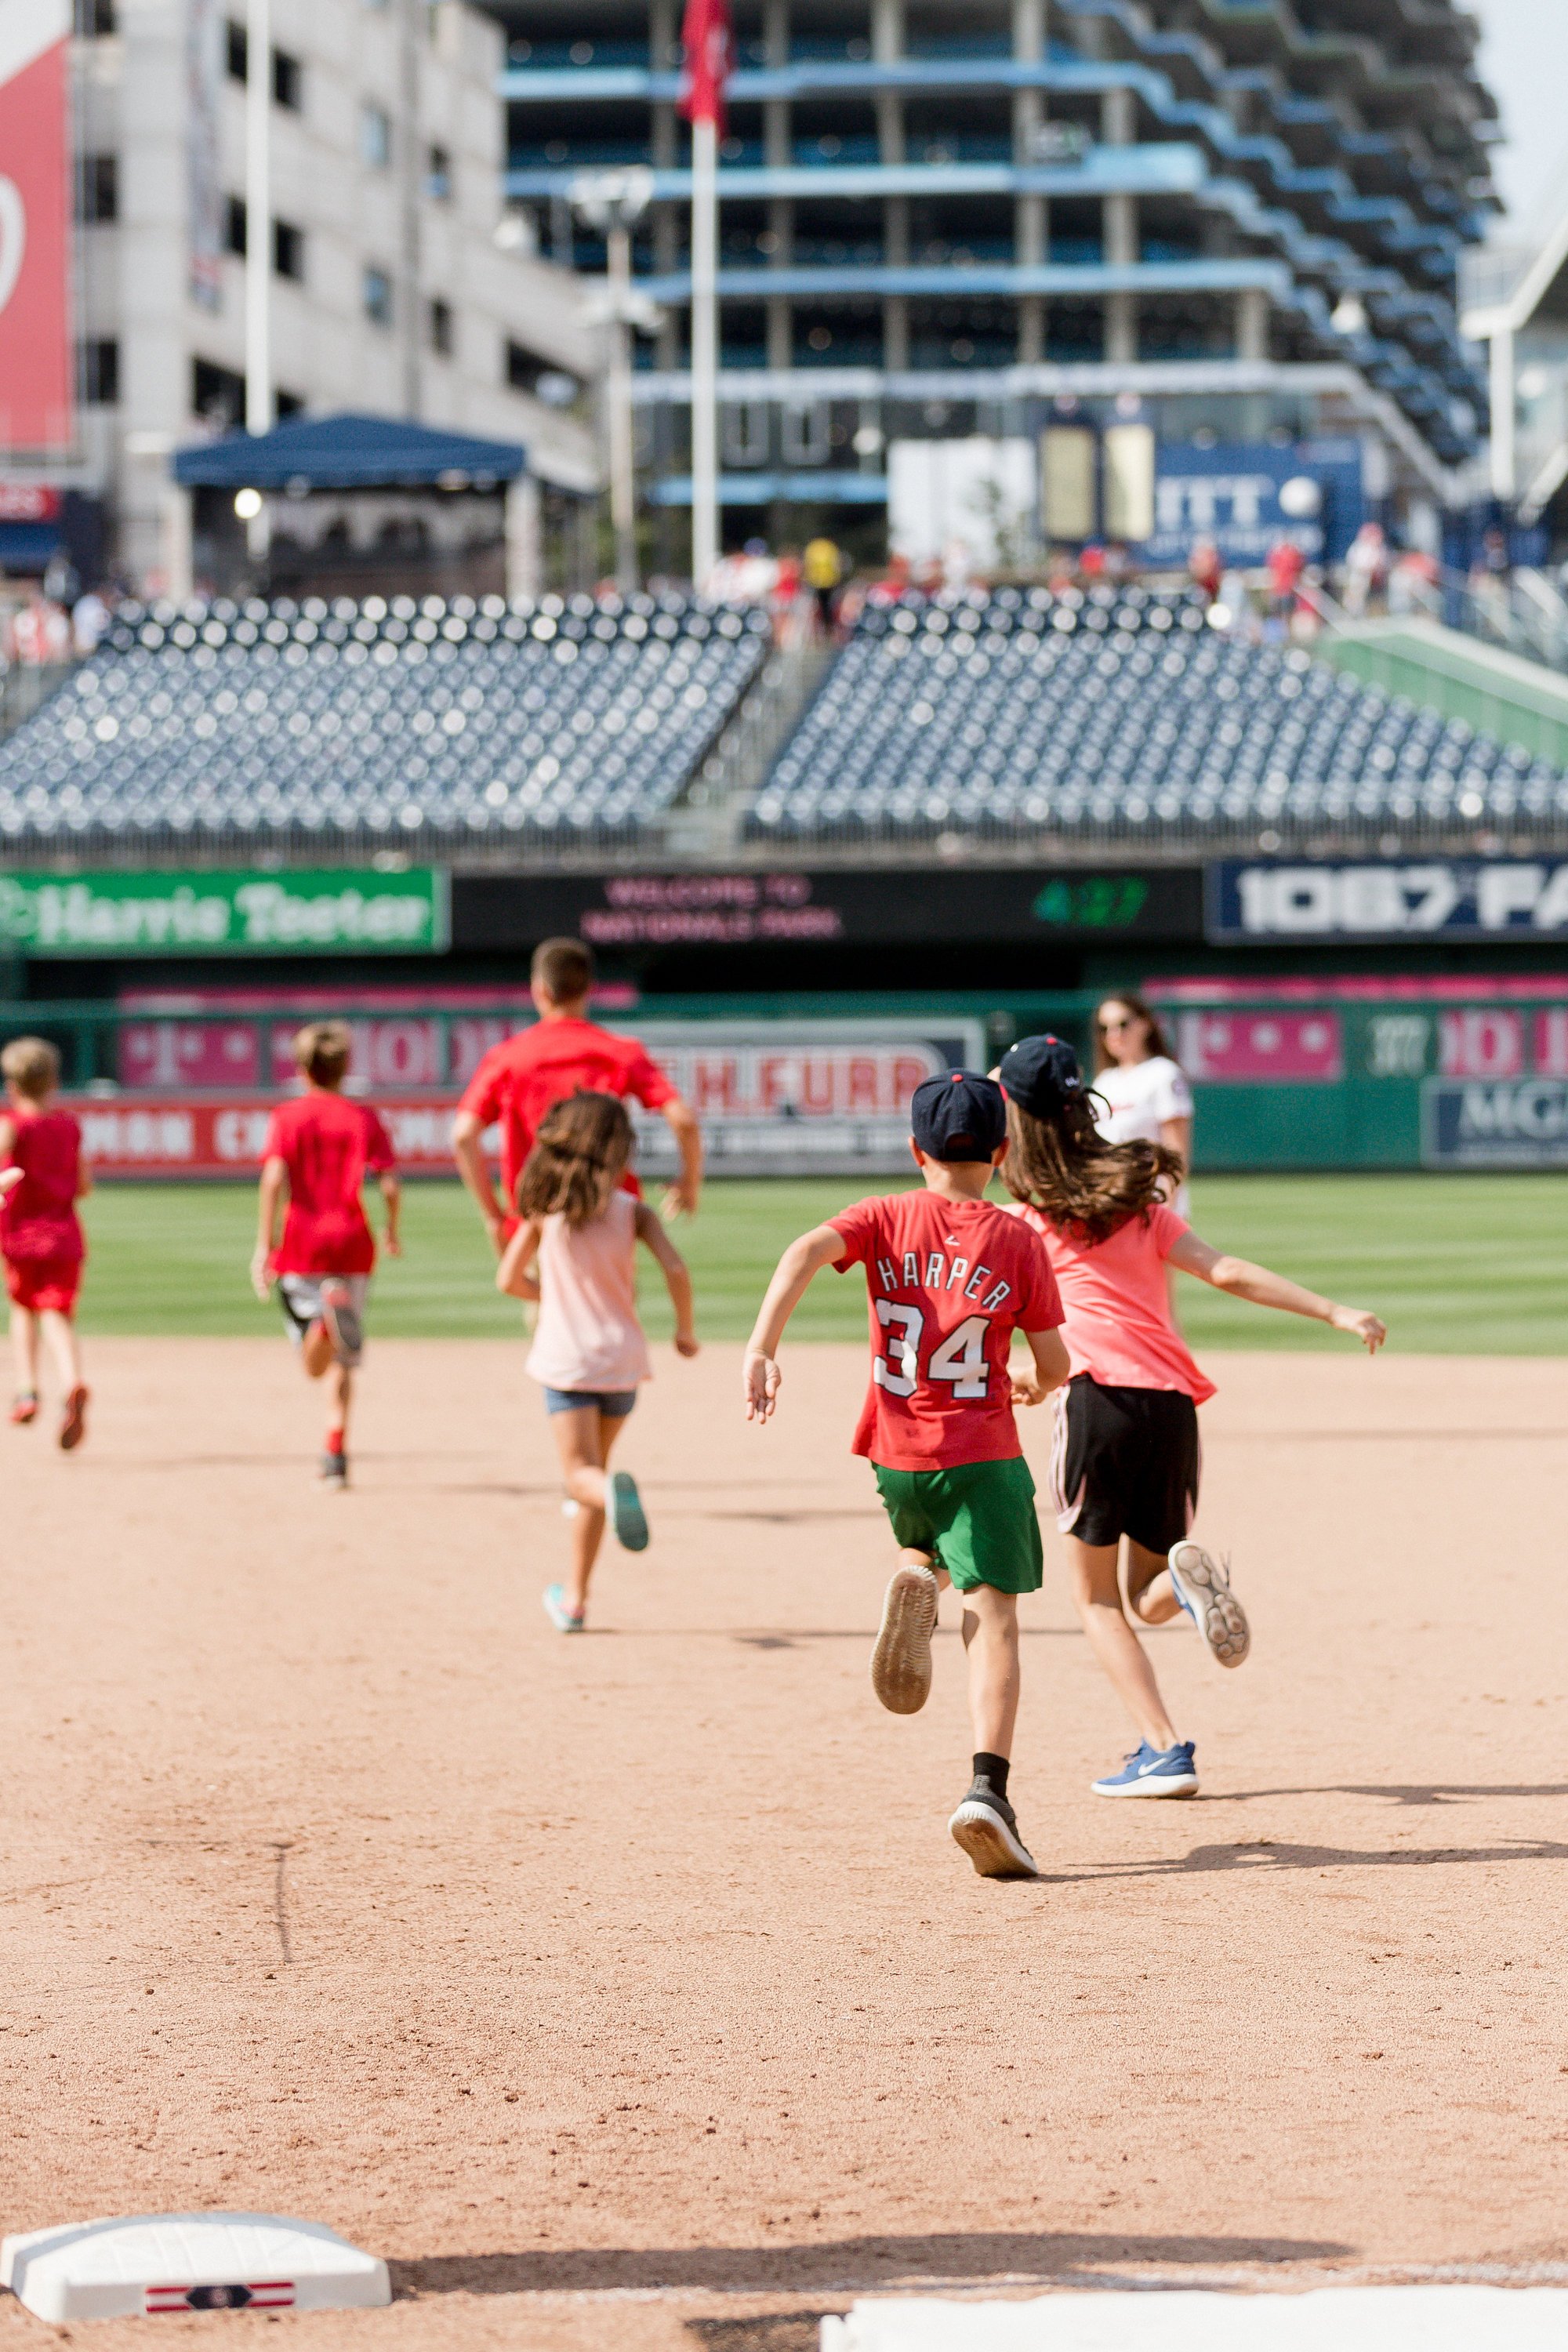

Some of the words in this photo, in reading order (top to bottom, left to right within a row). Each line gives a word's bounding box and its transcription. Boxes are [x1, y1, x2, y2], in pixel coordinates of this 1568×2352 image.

[38, 884, 230, 944] Harris
[236, 882, 428, 942] Teeter
[606, 877, 757, 906] WELCOME
[765, 876, 811, 905] TO
[581, 909, 752, 941] NATIONALS
[759, 907, 841, 939] PARK
[877, 1251, 1012, 1312] HARPER
[873, 1298, 991, 1399] 34
